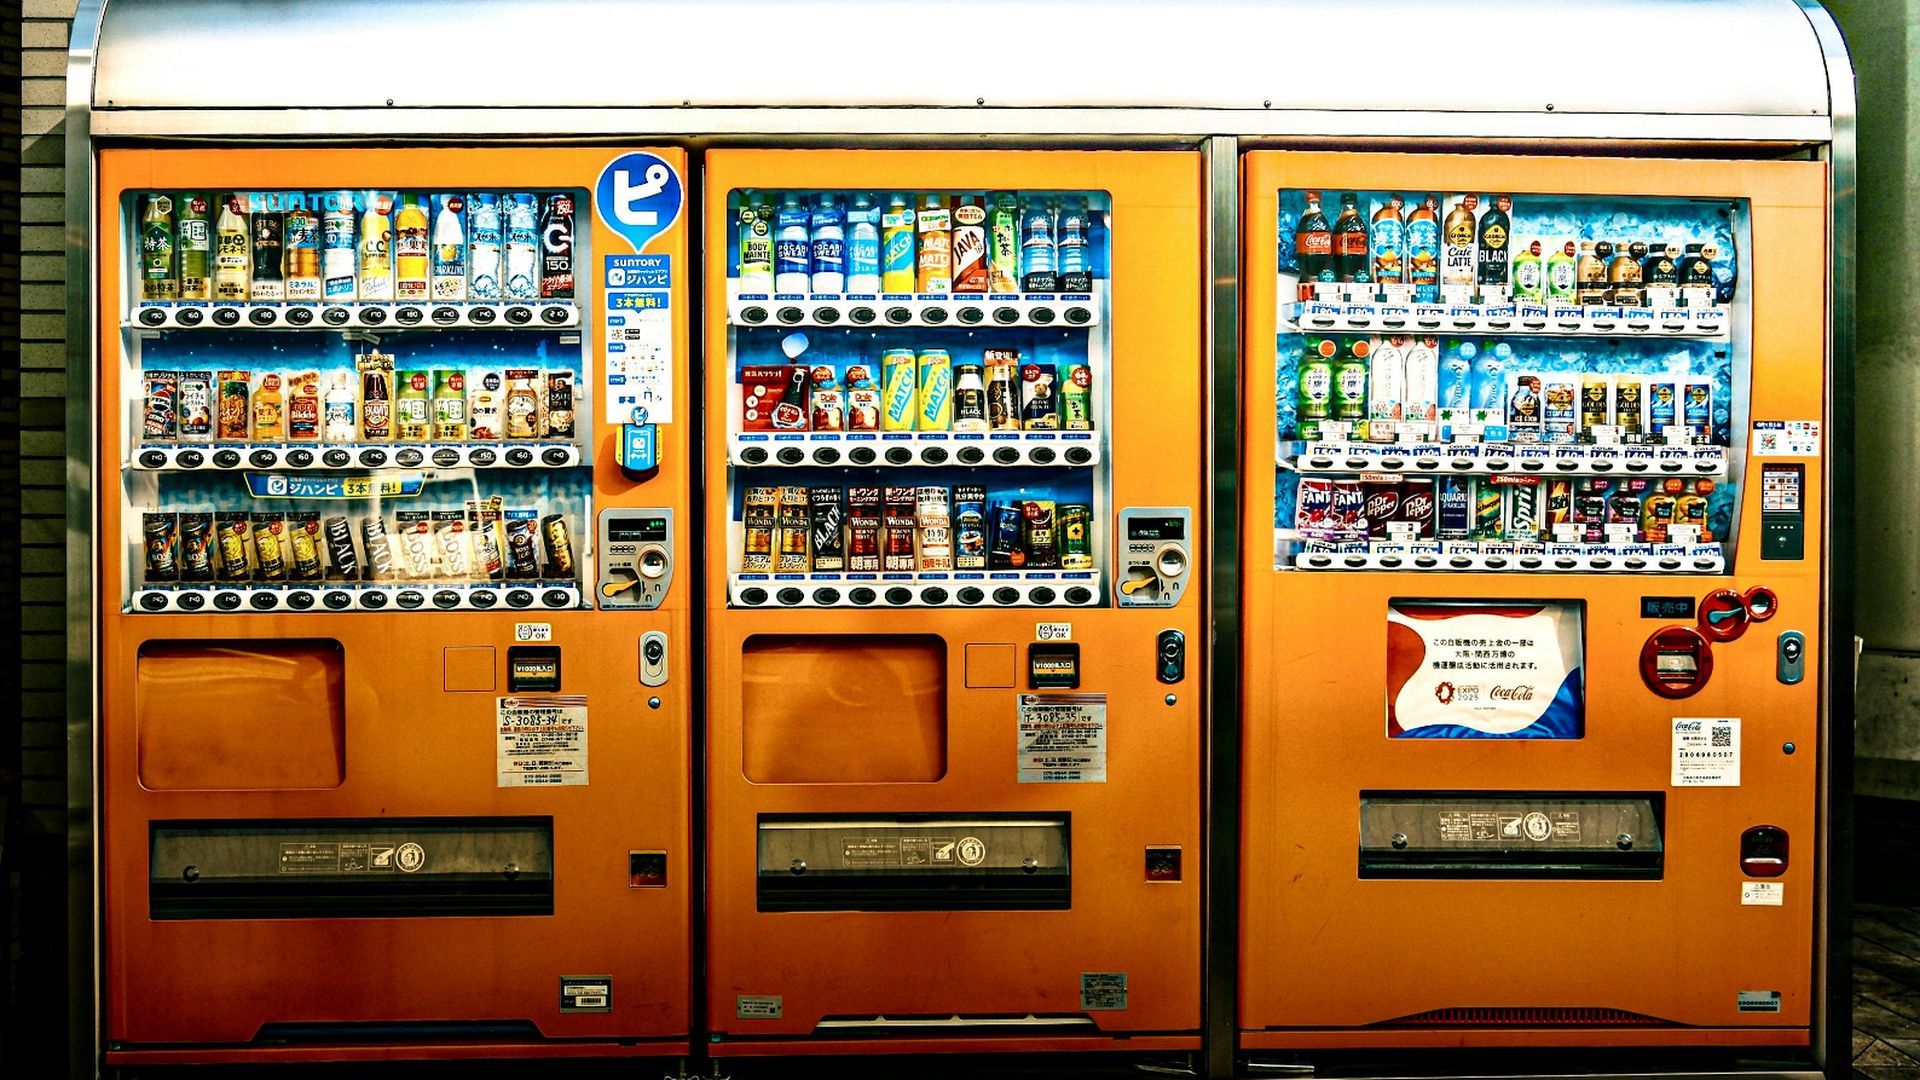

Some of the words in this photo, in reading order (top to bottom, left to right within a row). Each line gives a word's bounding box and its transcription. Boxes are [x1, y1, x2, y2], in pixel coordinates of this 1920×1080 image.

[614, 164, 669, 225] ピ
[144, 236, 172, 251] 特茶
[747, 242, 767, 250] BODY
[953, 231, 979, 265] JAVA
[744, 251, 770, 259] MAINTE
[1448, 247, 1472, 256] Café
[546, 261, 569, 270] 150
[1448, 257, 1471, 266] LATTE
[627, 275, 668, 284] ジハンピ
[821, 393, 837, 401] Dole
[855, 393, 872, 402] Dole
[889, 367, 914, 422] MATCH
[924, 367, 949, 422] MATCH
[289, 483, 337, 495] ジハンピ
[1376, 497, 1388, 505] Dr
[1415, 497, 1427, 505] Dr
[1368, 502, 1395, 516] Pepper
[1406, 502, 1432, 516] Pepper
[747, 518, 772, 526] WONDA
[782, 518, 808, 526] WONDA
[851, 518, 878, 526] WONDA
[887, 517, 914, 526] WONDA
[922, 517, 947, 525] WONDA
[815, 504, 841, 550] BLACK
[332, 523, 358, 574] BLACK
[368, 523, 393, 574] BLACK
[405, 532, 426, 573] BOSS
[442, 530, 463, 570] BOSS
[850, 556, 878, 570] 朝専用
[885, 556, 914, 570] 朝専用
[1647, 602, 1688, 614] 販売中
[1432, 662, 1538, 670] 機運醸成活動に活用されます。
[1490, 685, 1534, 701] Coca-Cola
[503, 715, 557, 726] S-3085-34
[1675, 722, 1702, 731] Coca-Cola
